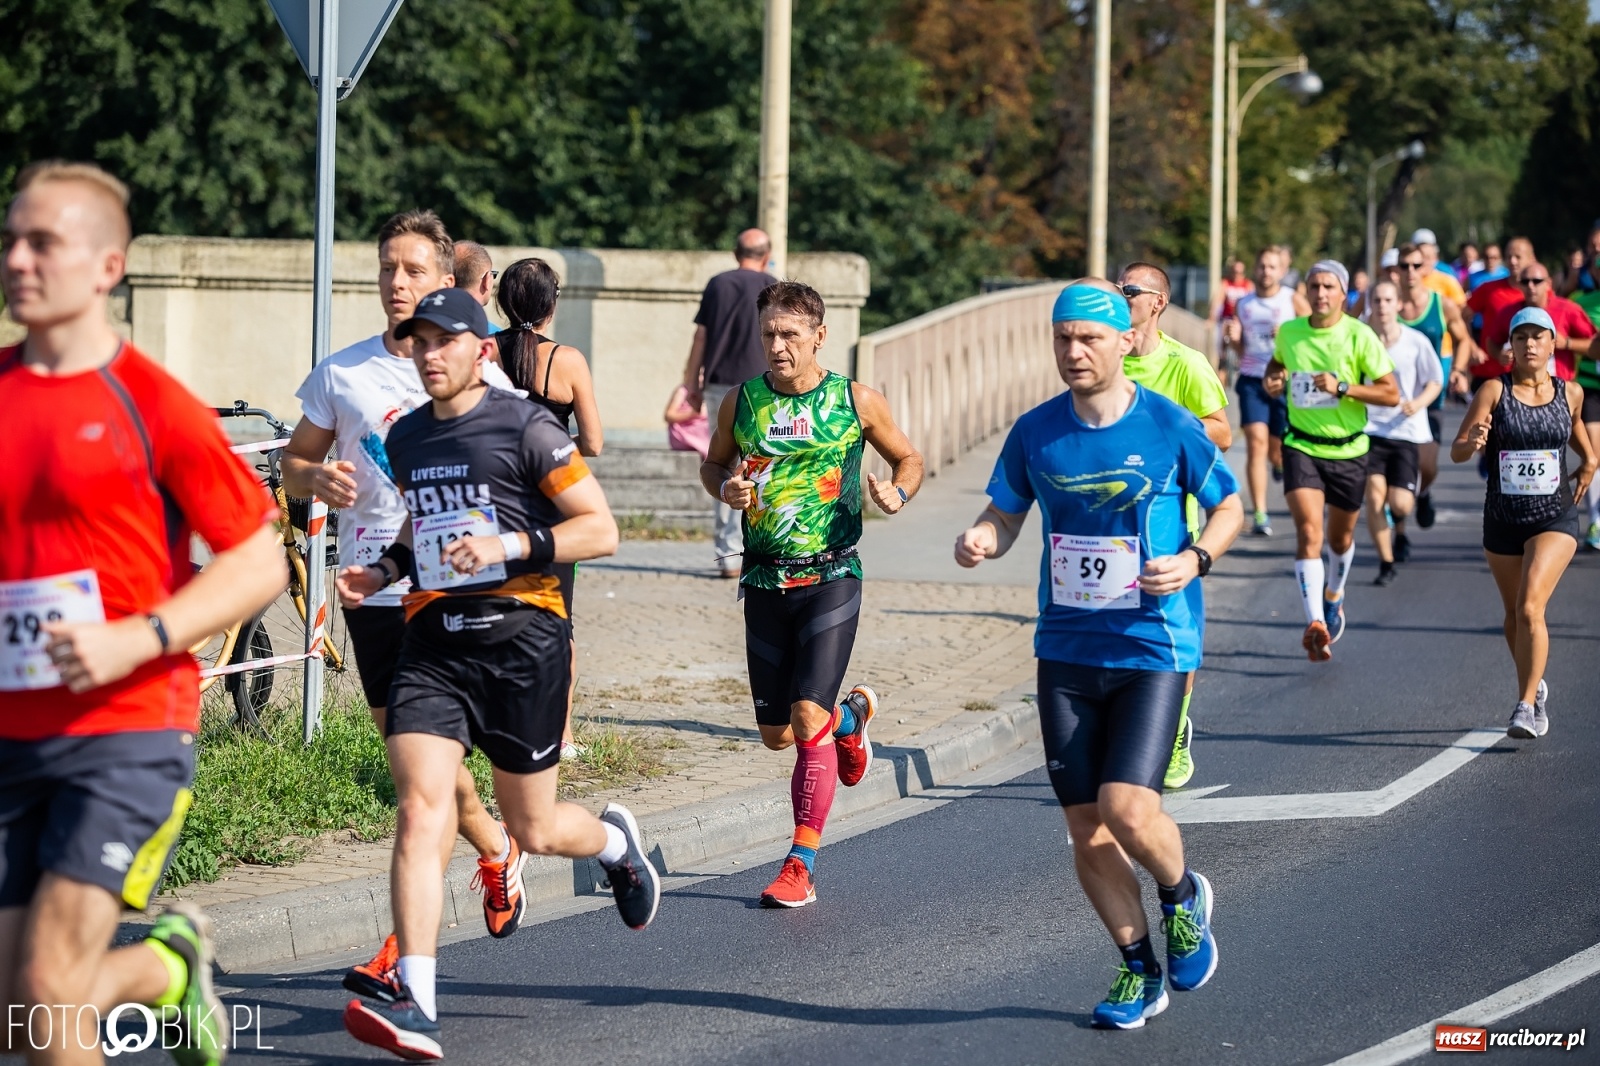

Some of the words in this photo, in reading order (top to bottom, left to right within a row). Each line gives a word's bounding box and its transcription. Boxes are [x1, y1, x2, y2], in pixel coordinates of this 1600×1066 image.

[411, 464, 470, 481] LIVECHAT
[1518, 462, 1545, 477] 265
[1080, 556, 1107, 580] 59
